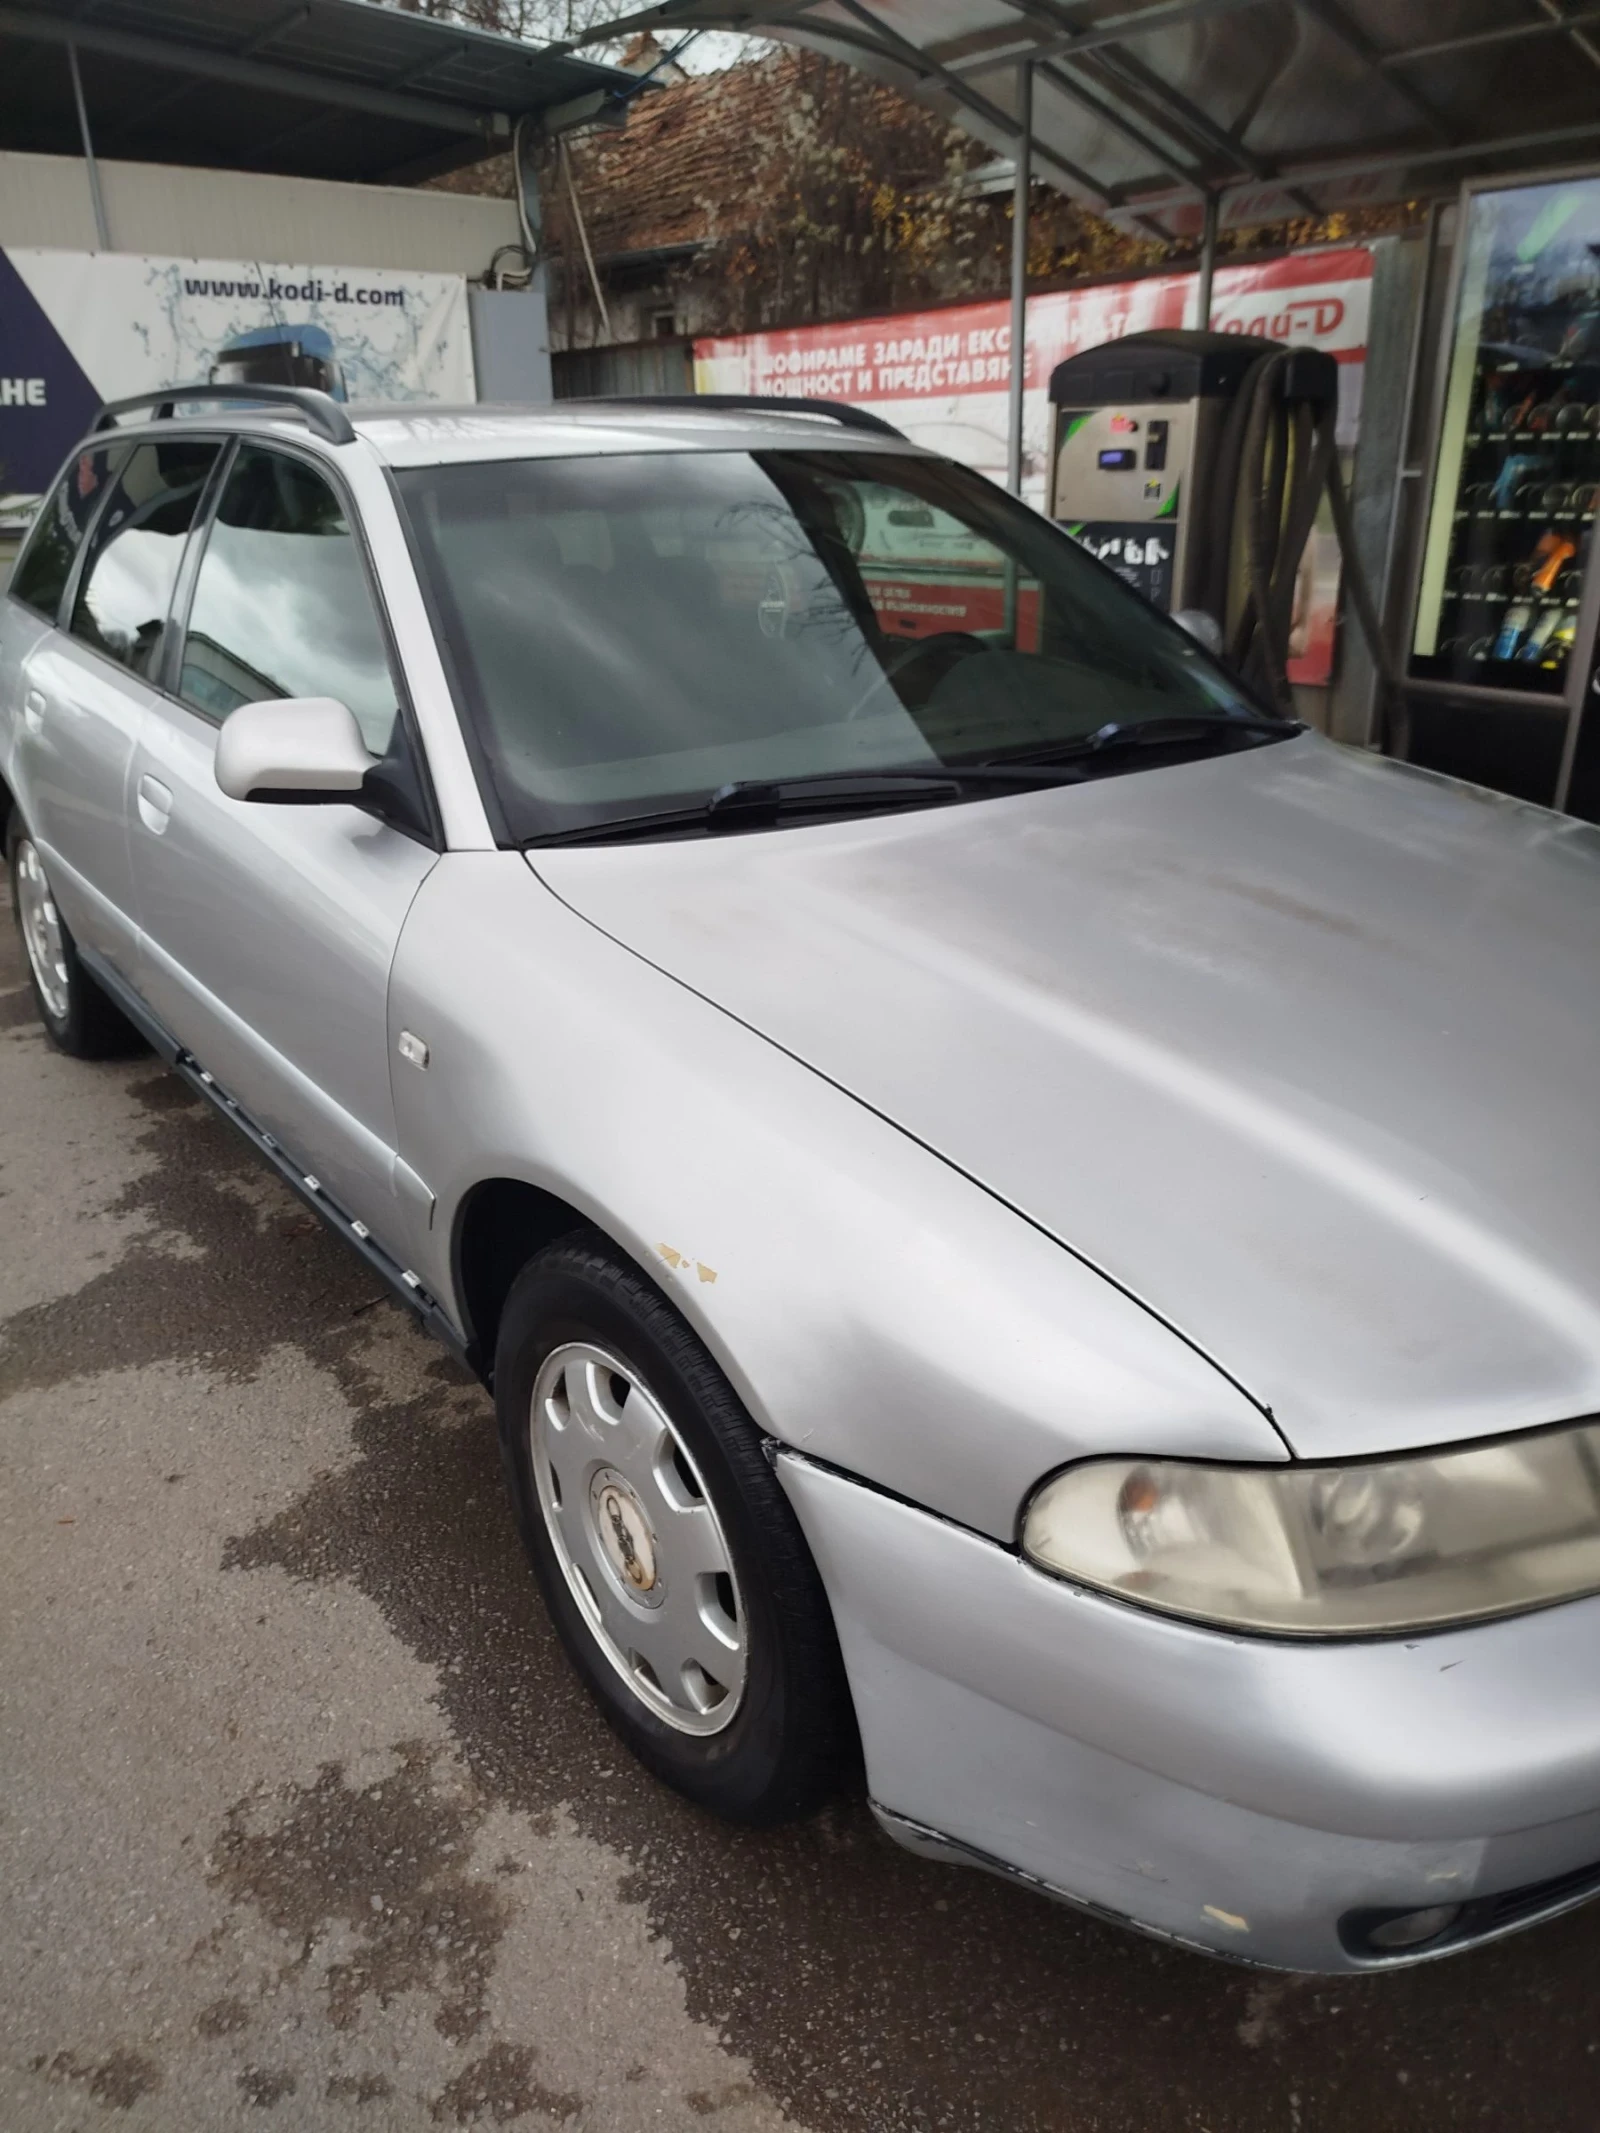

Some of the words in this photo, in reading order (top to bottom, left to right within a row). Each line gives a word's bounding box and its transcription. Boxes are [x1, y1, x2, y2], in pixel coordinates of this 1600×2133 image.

[184, 277, 405, 307] www.kodi-d.com
[872, 332, 961, 366] ЗАРАДИ
[0, 378, 47, 406] НЕ
[758, 371, 853, 397] МОЩНОСТ
[857, 368, 873, 393] И
